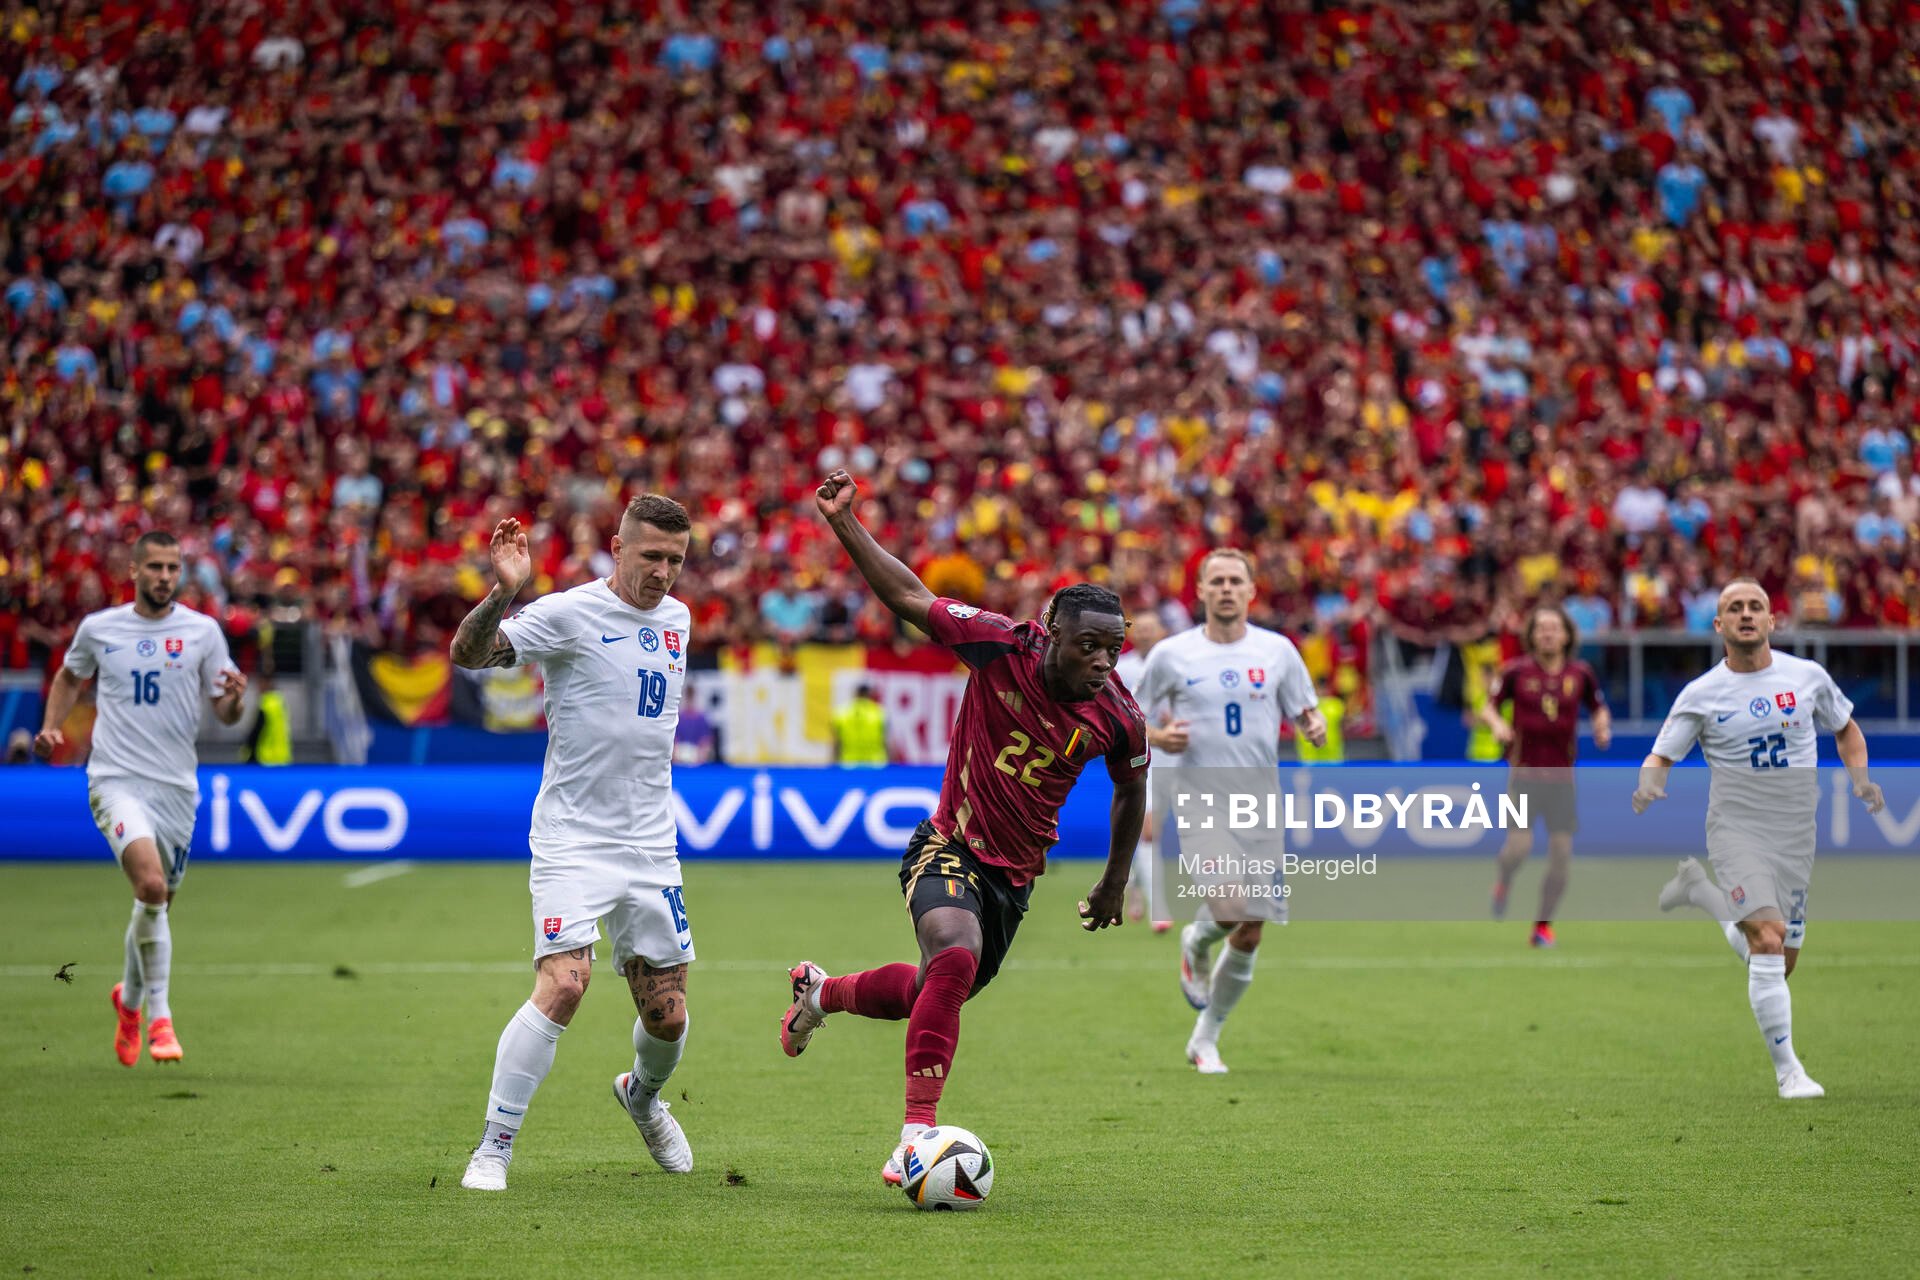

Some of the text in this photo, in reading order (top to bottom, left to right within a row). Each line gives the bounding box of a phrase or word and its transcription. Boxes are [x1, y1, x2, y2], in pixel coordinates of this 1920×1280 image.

[131, 670, 160, 706] 16
[637, 668, 667, 718] 19
[1225, 702, 1242, 737] 8
[994, 730, 1055, 788] 22
[1748, 733, 1789, 772] 22
[196, 773, 409, 852] ivo
[671, 773, 940, 851] vivo
